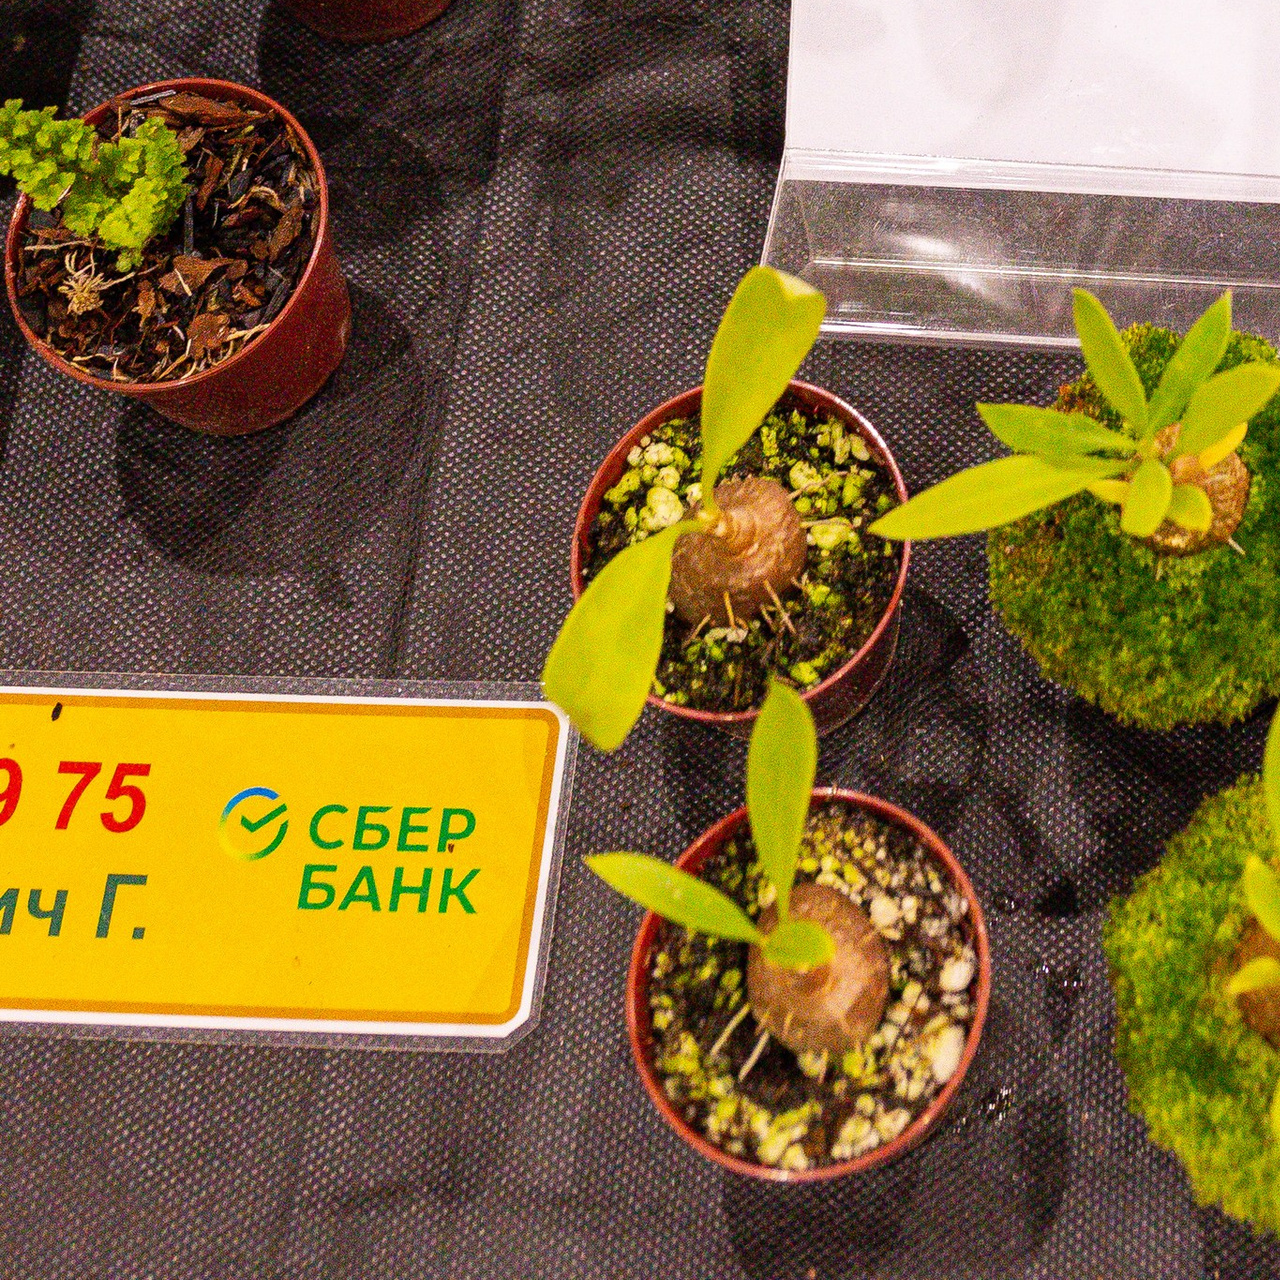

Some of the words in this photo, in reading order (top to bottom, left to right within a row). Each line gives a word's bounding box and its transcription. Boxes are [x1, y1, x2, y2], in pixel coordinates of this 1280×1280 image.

[56, 761, 150, 833] 75
[309, 804, 476, 853] СБЕР
[95, 873, 148, 939] Г.
[297, 864, 480, 914] БАНК
